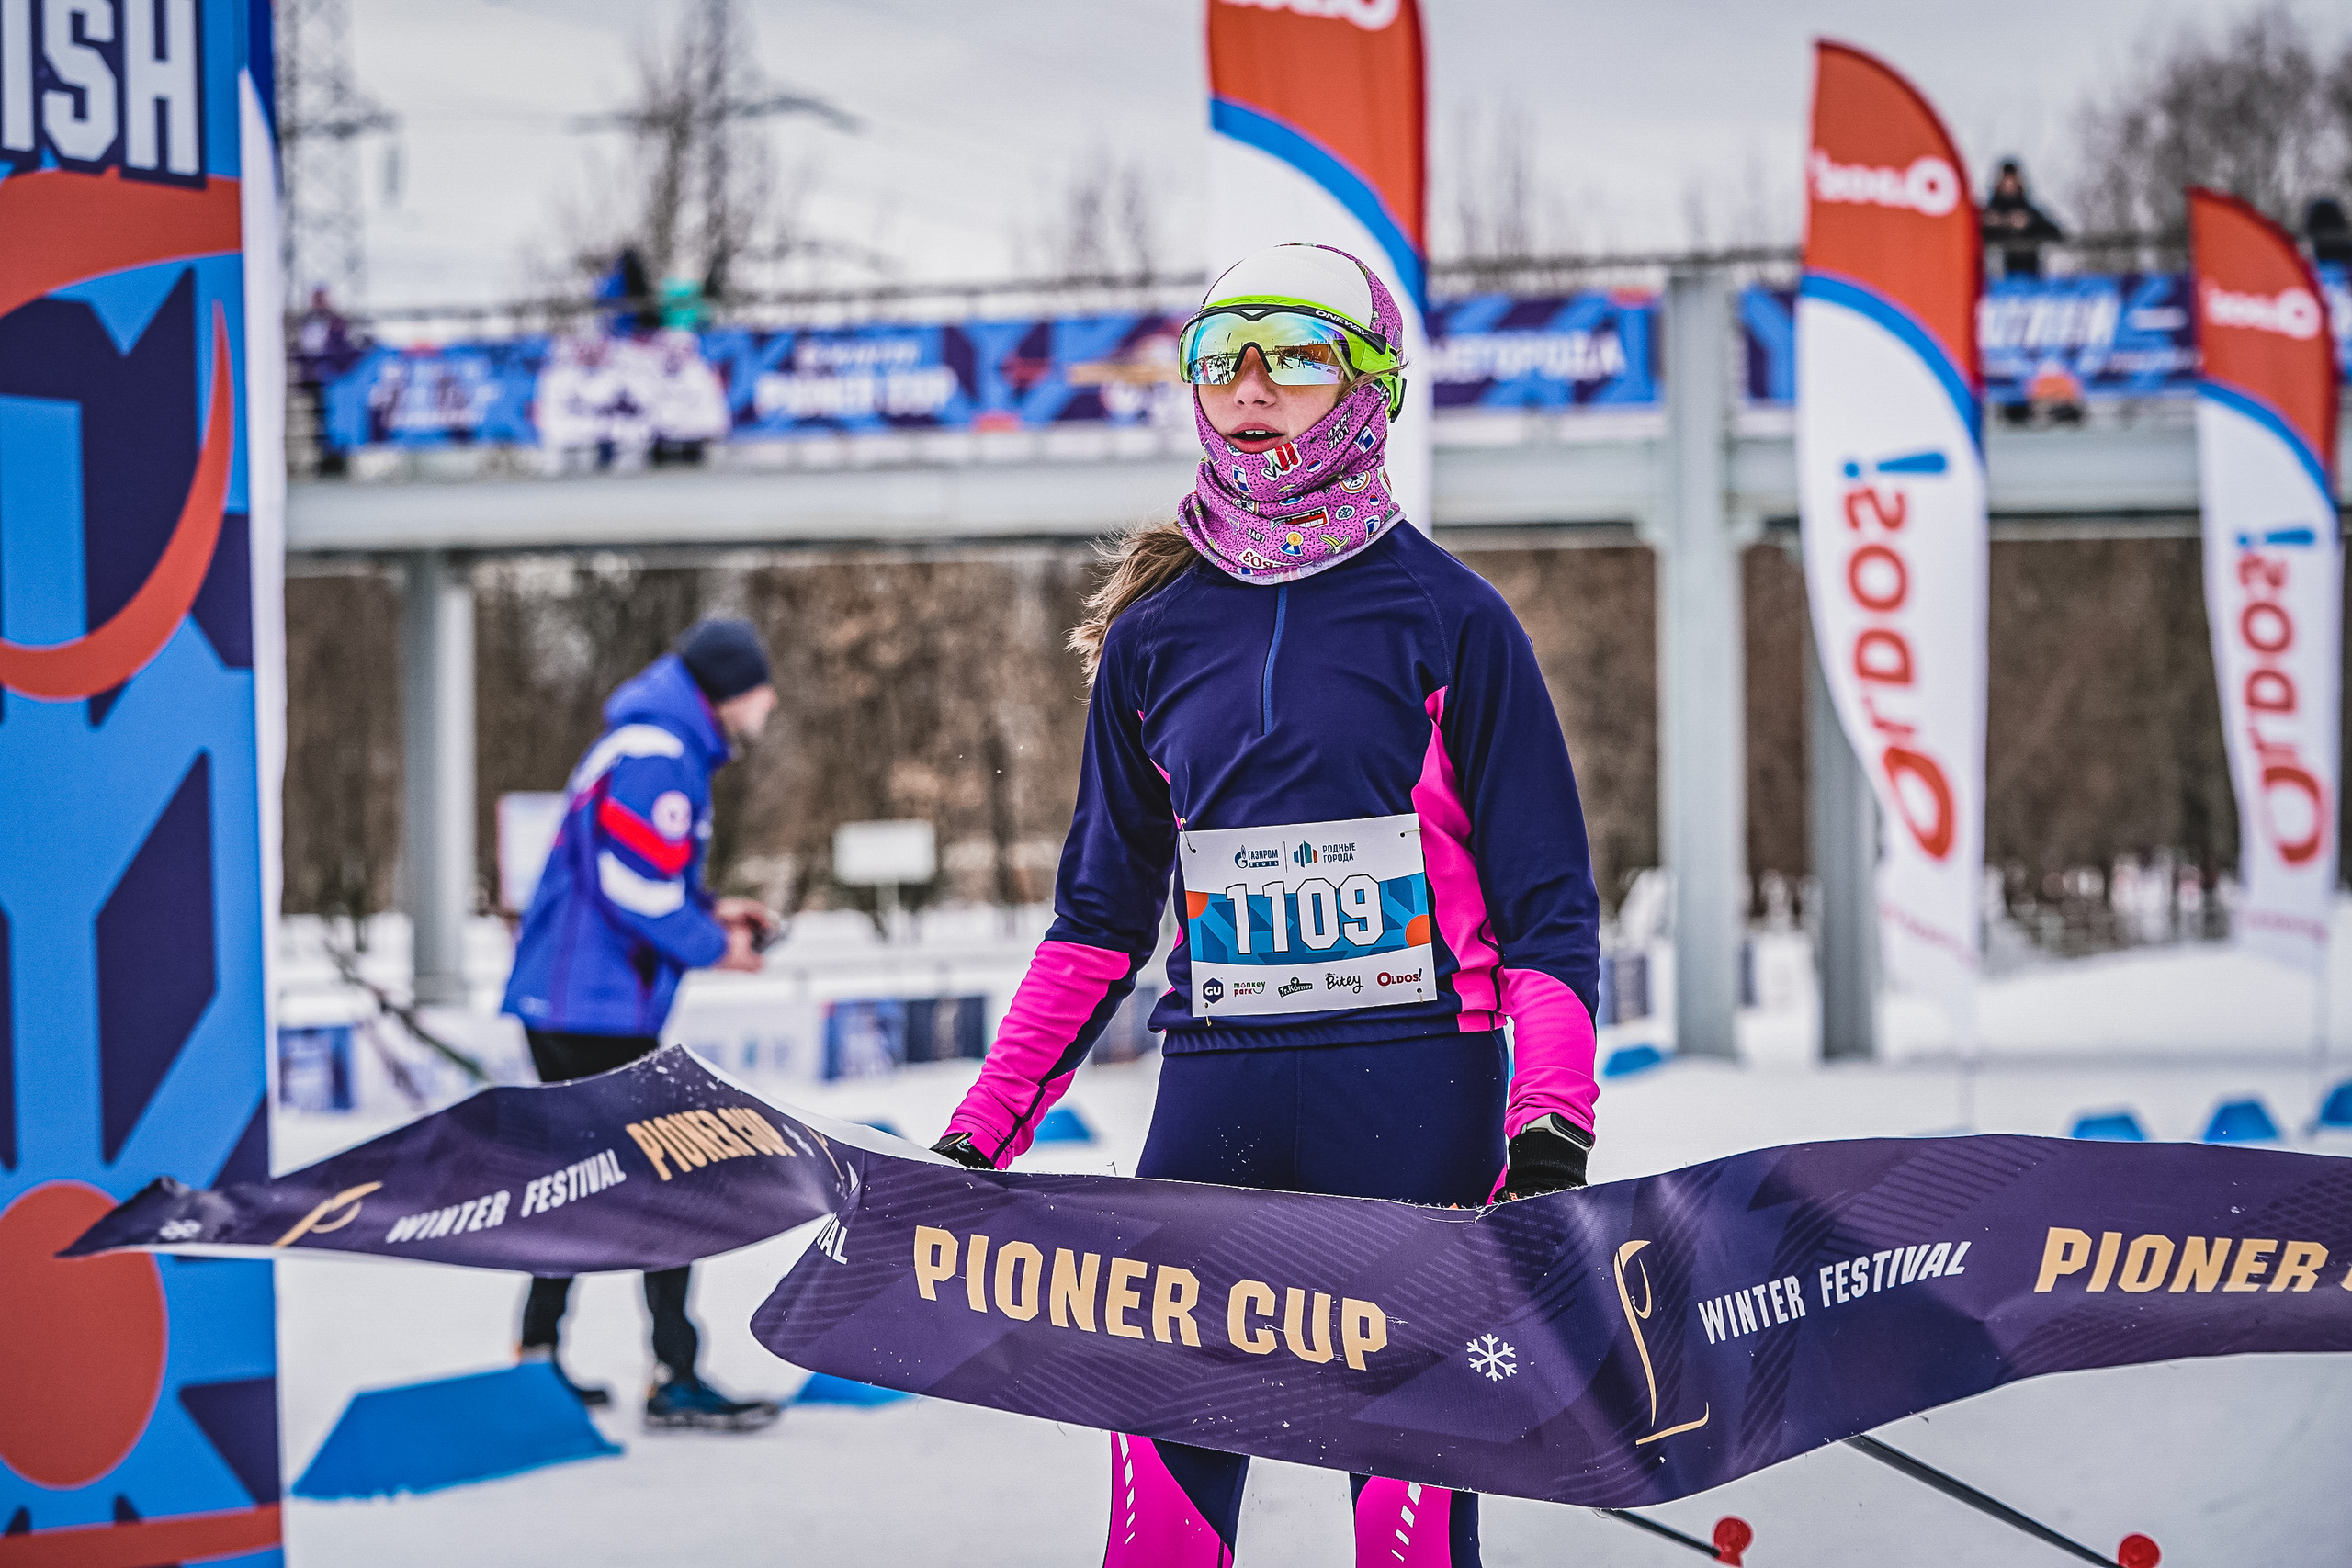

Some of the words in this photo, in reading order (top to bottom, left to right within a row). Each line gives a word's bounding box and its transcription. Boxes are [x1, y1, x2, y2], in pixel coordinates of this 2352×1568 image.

[1315, 310, 1369, 335] ONEWAY
[1328, 425, 1350, 450] LOVE
[1248, 528, 1266, 544] LOVE
[1248, 849, 1278, 860] ГАЗПРОМ
[1322, 842, 1356, 853] РОДНЫЕ
[1323, 852, 1354, 863] ГОРОДА
[1225, 874, 1385, 955] 1109
[1233, 981, 1266, 994] monkey
[1325, 972, 1364, 994] Bitey
[1377, 968, 1422, 987] OLDOS!
[1204, 987, 1221, 996] GU
[1234, 988, 1253, 997] park
[386, 1190, 510, 1244] WINTER
[520, 1148, 627, 1218] FESTIVAL
[2034, 1227, 2330, 1293] PIONER
[914, 1225, 1201, 1348] PIONER
[1227, 1279, 1387, 1371] CUP
[1698, 1275, 1807, 1345] WINTER
[1819, 1241, 1972, 1308] FESTIVAL
